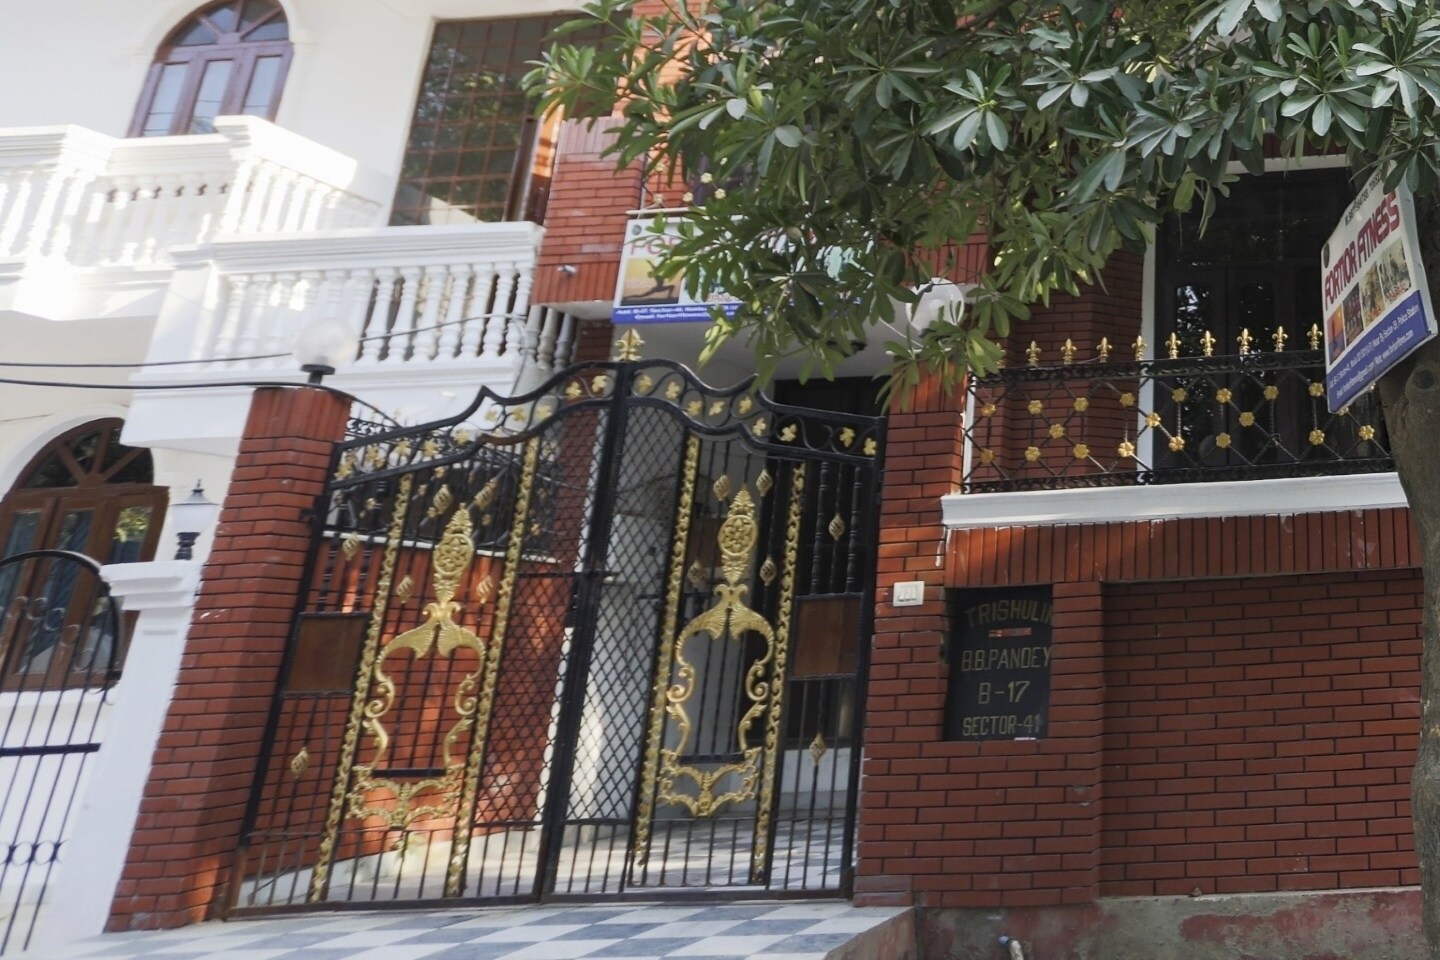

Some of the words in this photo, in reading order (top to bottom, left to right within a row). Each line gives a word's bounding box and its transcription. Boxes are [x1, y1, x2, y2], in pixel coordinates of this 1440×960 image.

[1324, 240, 1358, 311] FORTIOR
[1357, 190, 1400, 269] FITNESS
[962, 713, 1041, 737] SECTOR-41
